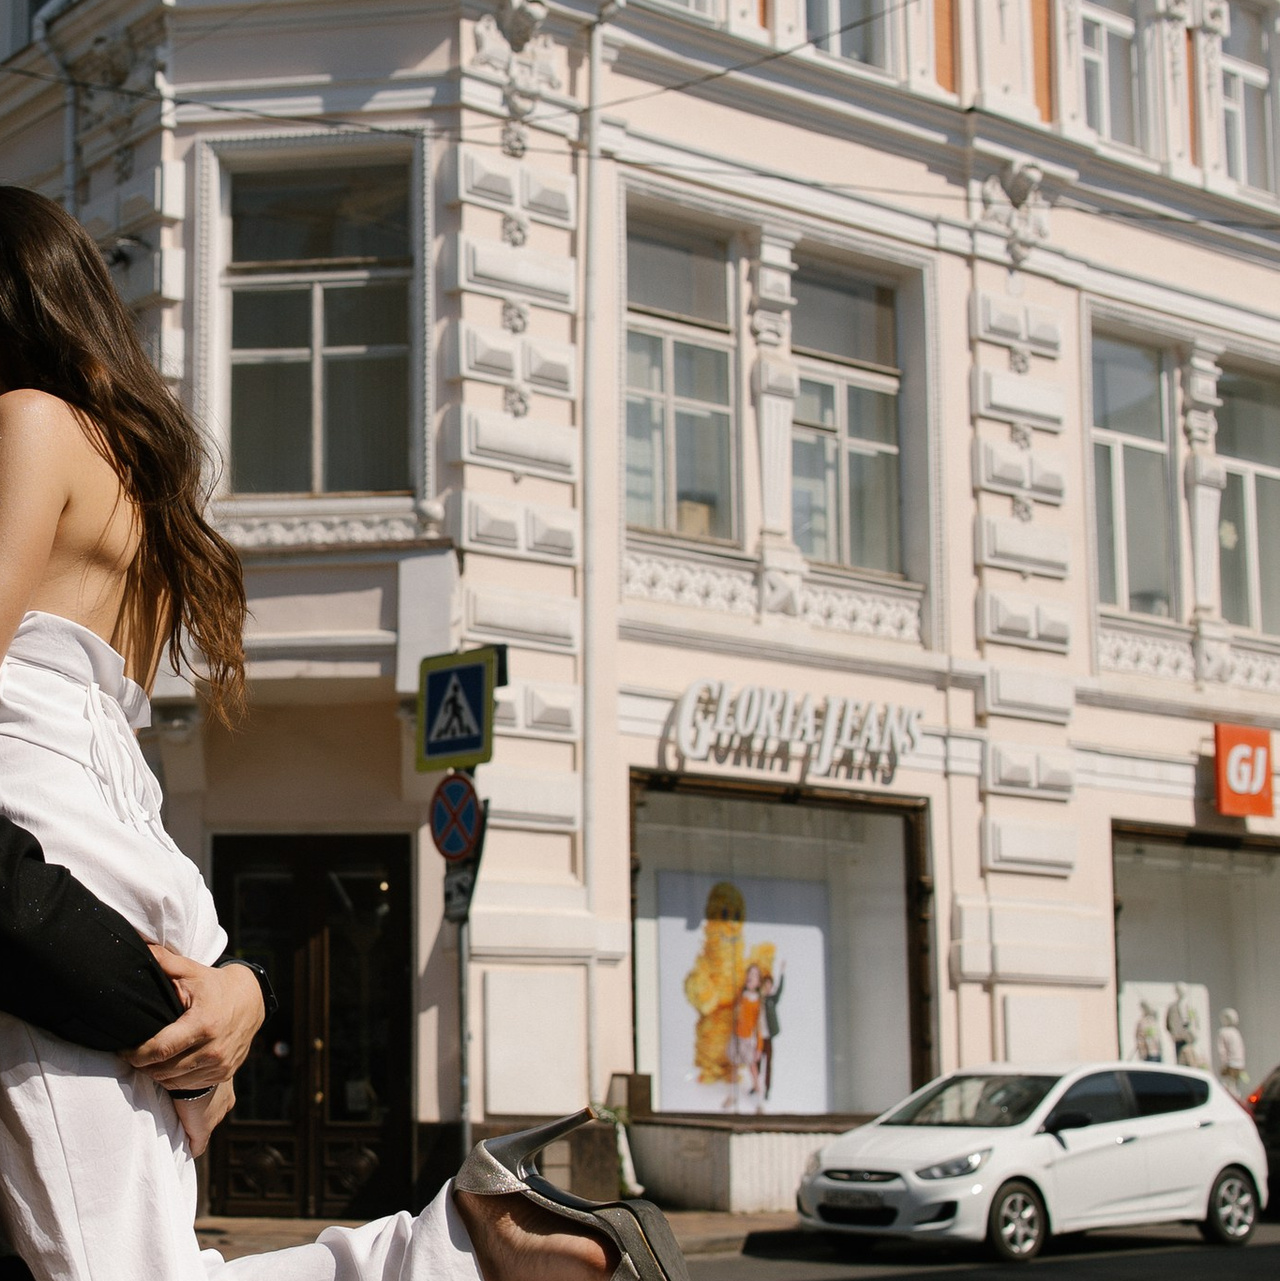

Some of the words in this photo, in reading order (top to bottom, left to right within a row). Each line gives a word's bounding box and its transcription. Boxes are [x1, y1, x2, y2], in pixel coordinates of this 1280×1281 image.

[677, 679, 818, 760] GLORIA
[807, 694, 923, 777] JEANS
[1227, 744, 1267, 796] GJ
